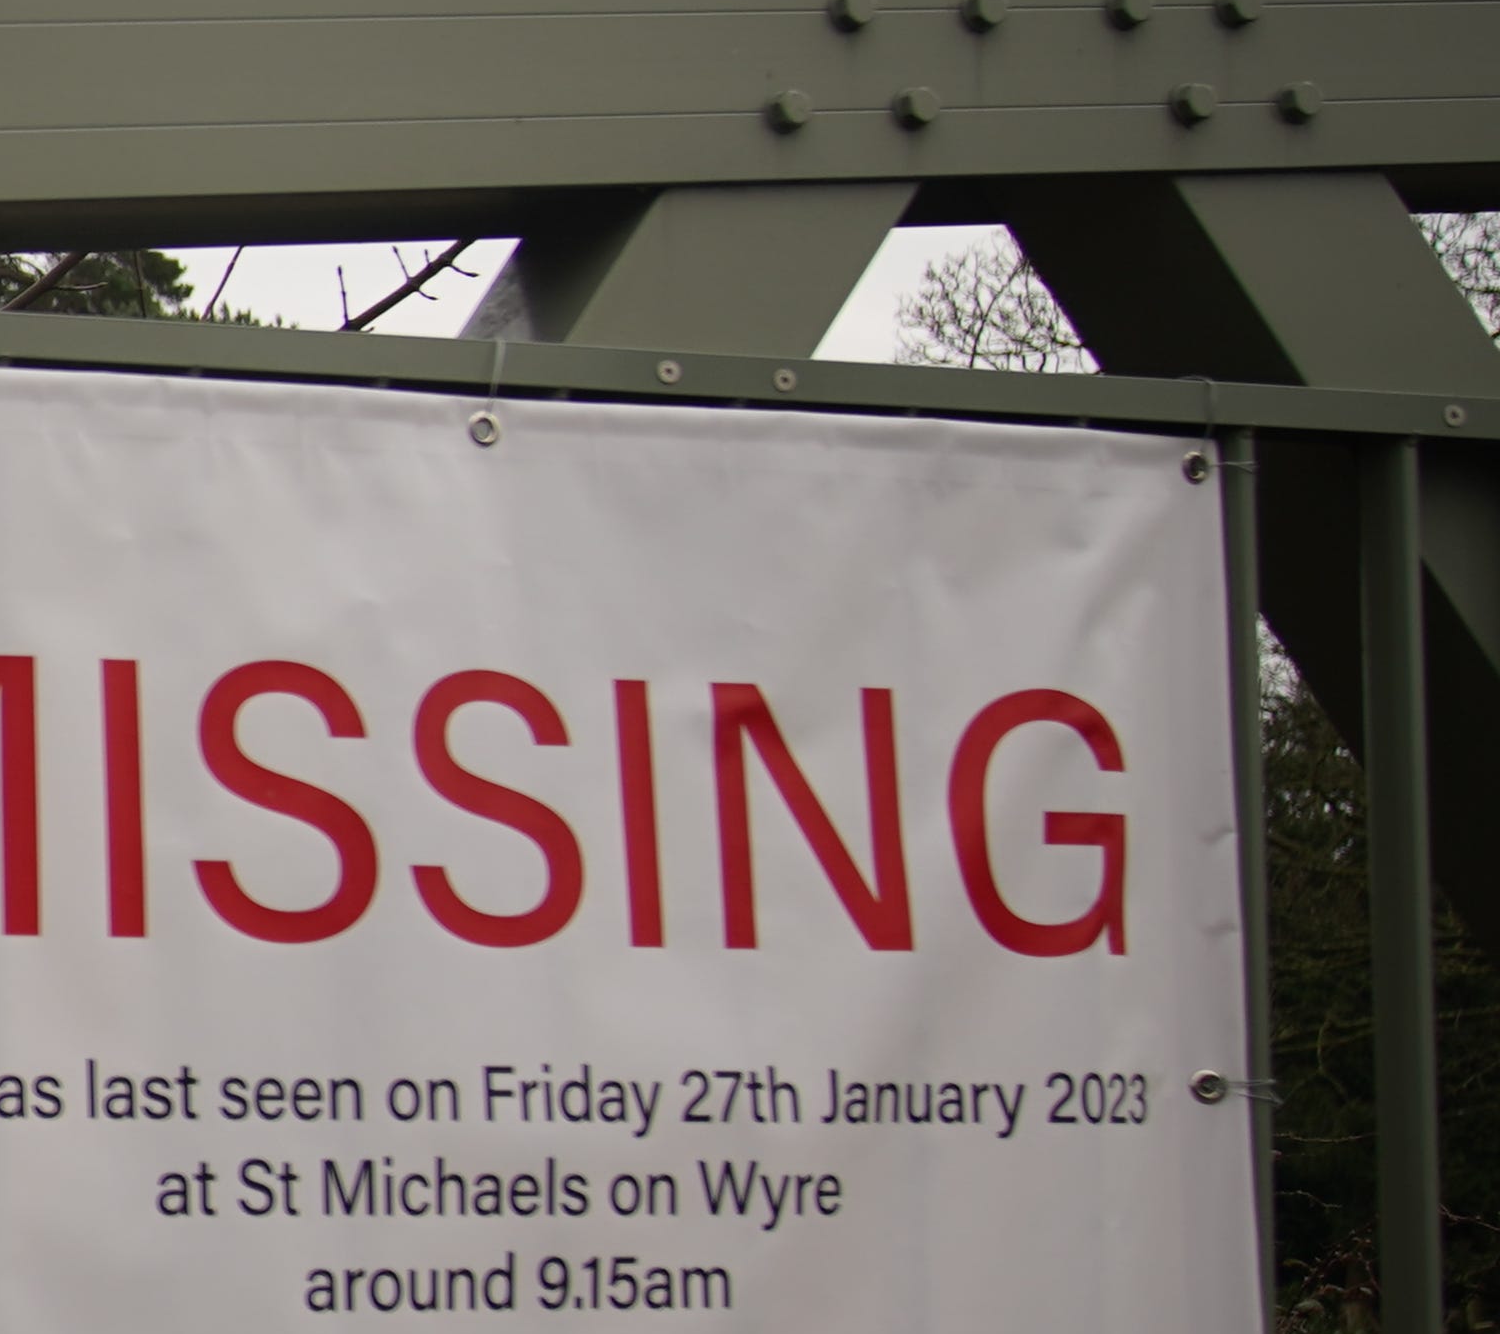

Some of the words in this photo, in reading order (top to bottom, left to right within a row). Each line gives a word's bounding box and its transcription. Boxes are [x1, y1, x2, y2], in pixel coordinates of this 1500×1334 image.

[86, 1058, 200, 1121] last
[219, 1075, 364, 1122] seen
[386, 1077, 460, 1122] on
[483, 1063, 662, 1139] Friday
[680, 1065, 801, 1124] 27th
[821, 1068, 1026, 1140] January
[1045, 1071, 1148, 1125] 2023
[155, 1160, 217, 1217] at
[238, 1157, 300, 1217] St
[322, 1156, 590, 1217] Michaels
[609, 1173, 678, 1217] on
[697, 1160, 843, 1232] Wyre
[305, 1251, 516, 1313] around
[537, 1255, 732, 1311] 9.15am
